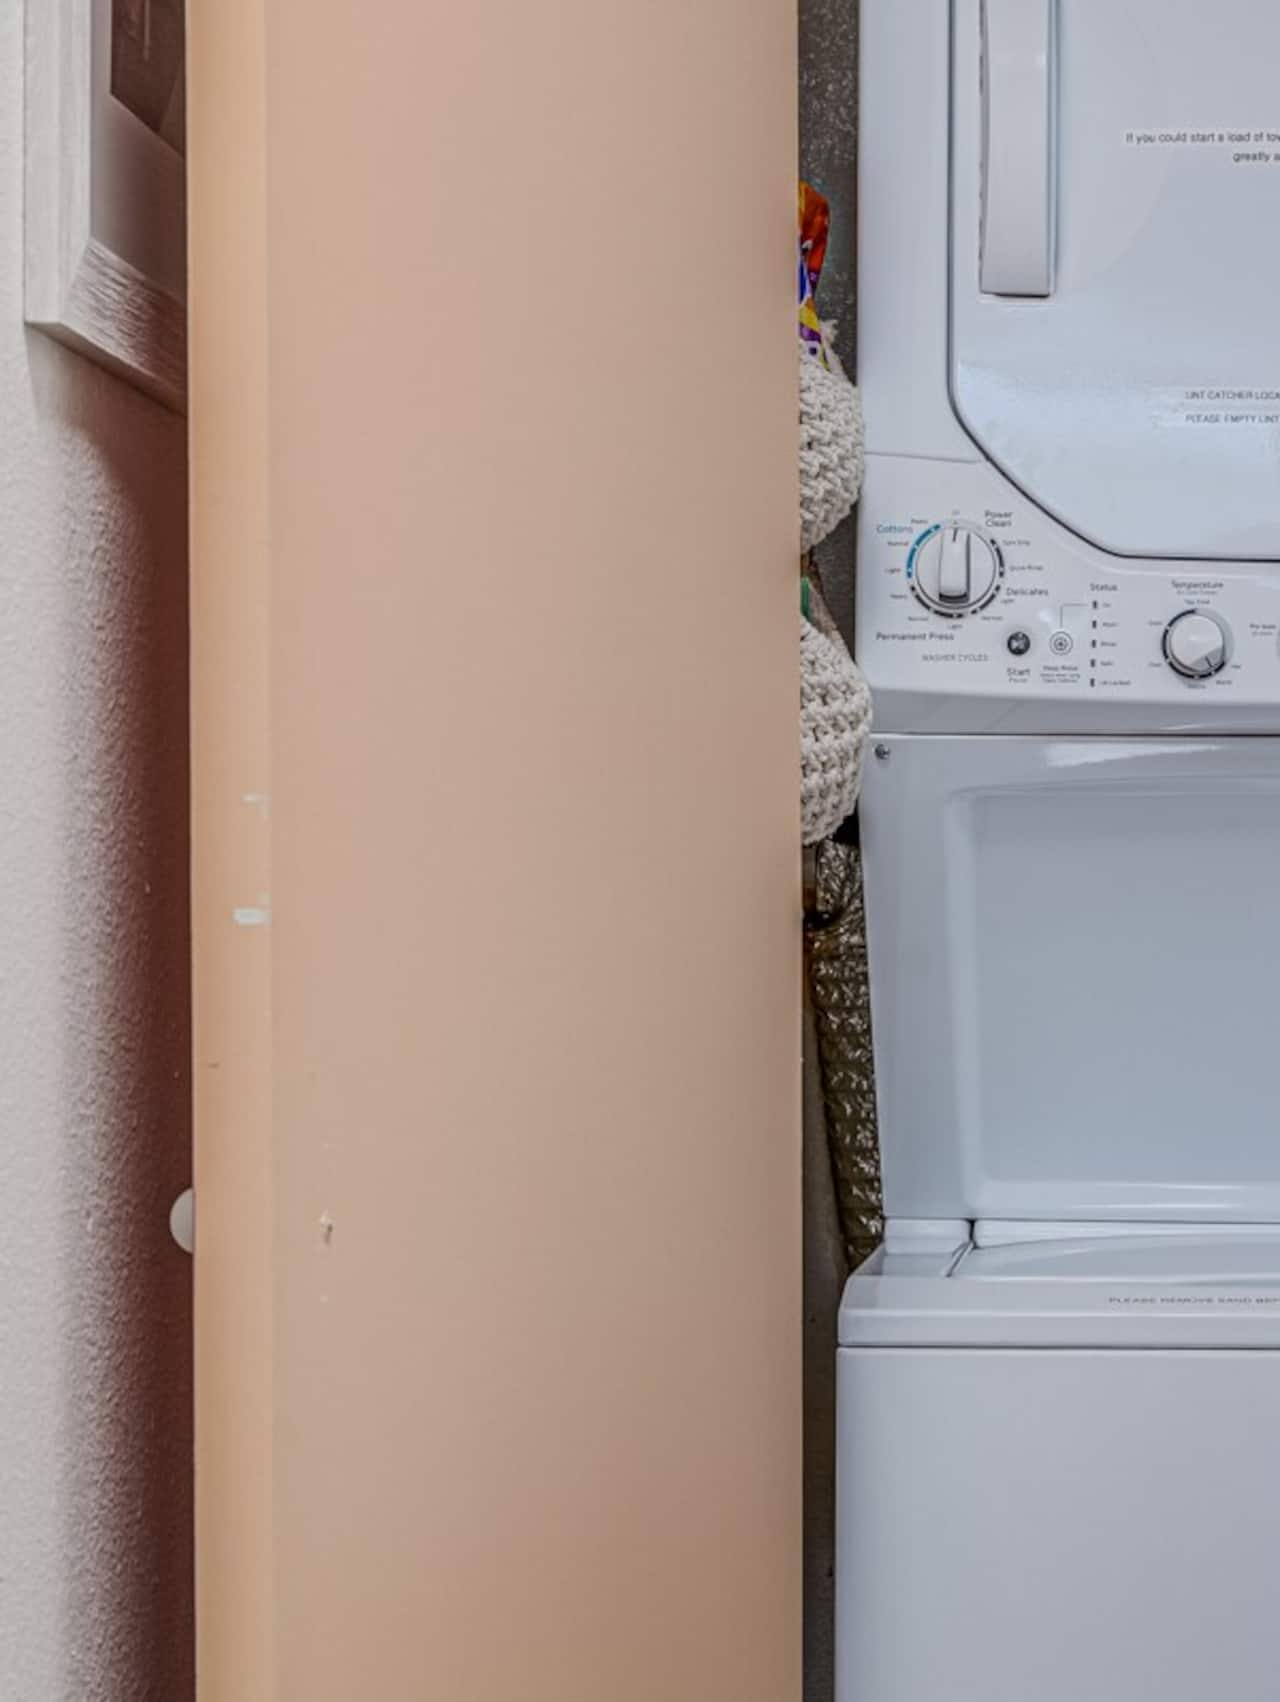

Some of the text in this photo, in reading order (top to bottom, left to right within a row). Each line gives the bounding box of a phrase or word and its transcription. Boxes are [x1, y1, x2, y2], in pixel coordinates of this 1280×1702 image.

[1136, 133, 1154, 145] you
[1158, 132, 1187, 142] could
[1190, 132, 1215, 142] start
[1227, 132, 1251, 142] load
[1253, 132, 1264, 142] of
[1232, 151, 1270, 163] greatly
[1185, 391, 1205, 400] LINT
[1207, 391, 1253, 401] CATCHER
[1185, 414, 1220, 424] PLEASE
[1089, 583, 1119, 592] Status
[875, 632, 955, 641] Permanent Press
[1007, 667, 1031, 677] Start
